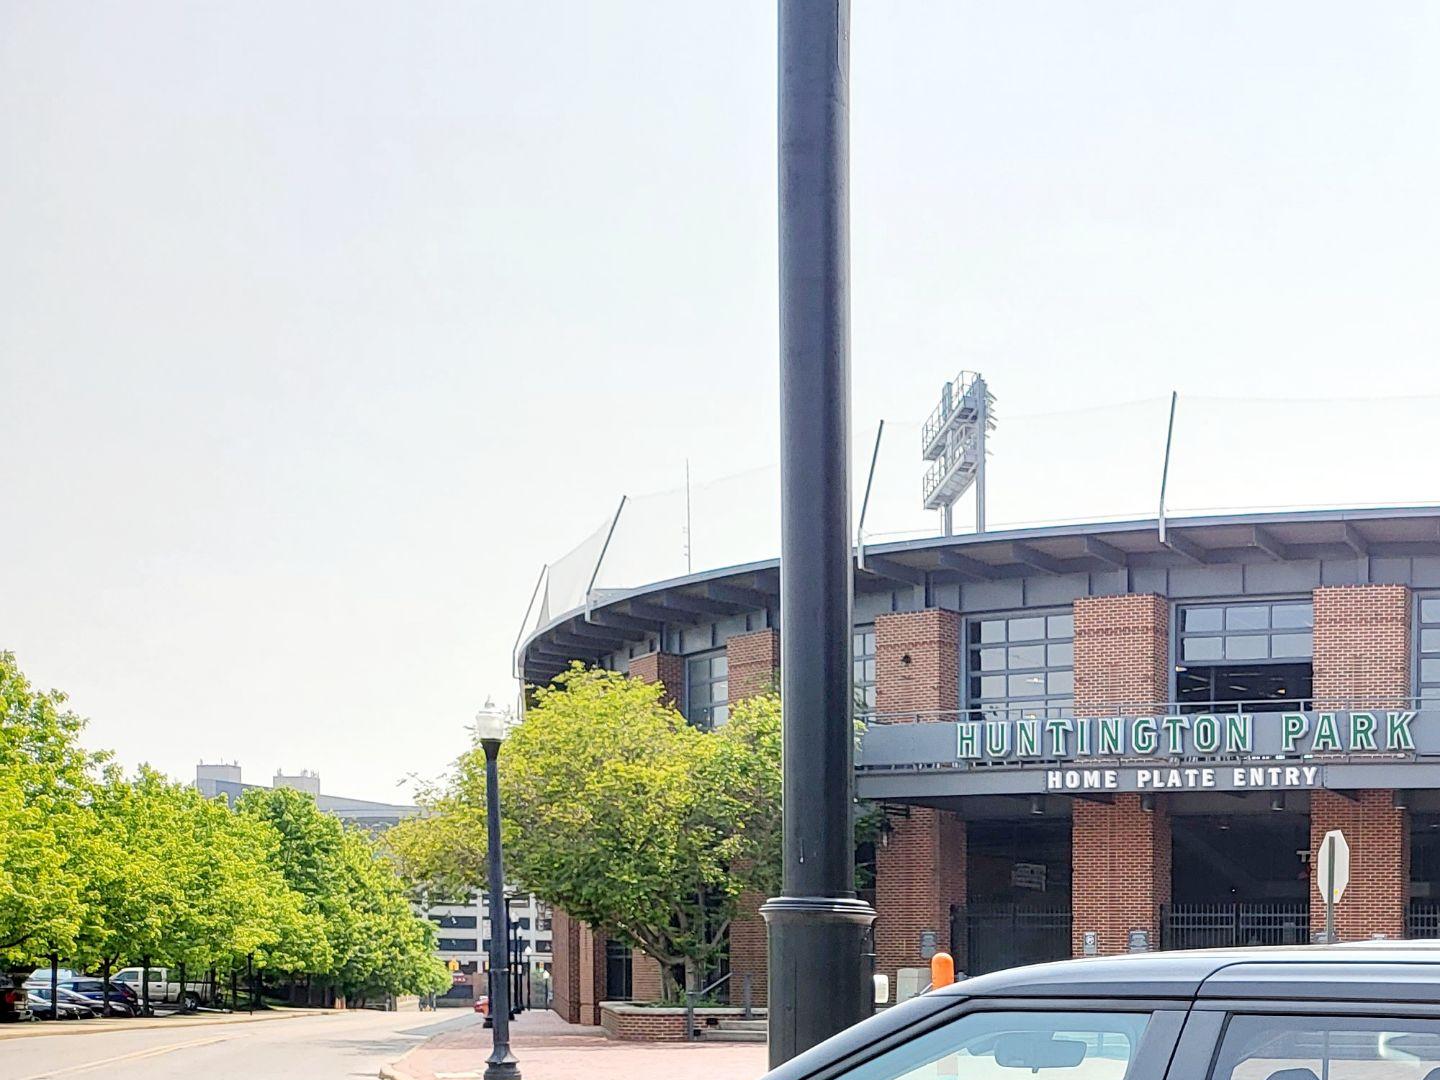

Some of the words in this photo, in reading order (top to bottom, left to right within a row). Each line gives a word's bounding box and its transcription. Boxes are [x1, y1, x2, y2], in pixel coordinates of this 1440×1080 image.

[957, 715, 1254, 759] HUNTINGTON
[1281, 711, 1420, 752] PARK
[1048, 770, 1118, 789] HOME
[1137, 768, 1216, 788] PLATE
[1233, 766, 1318, 787] ENTRY
